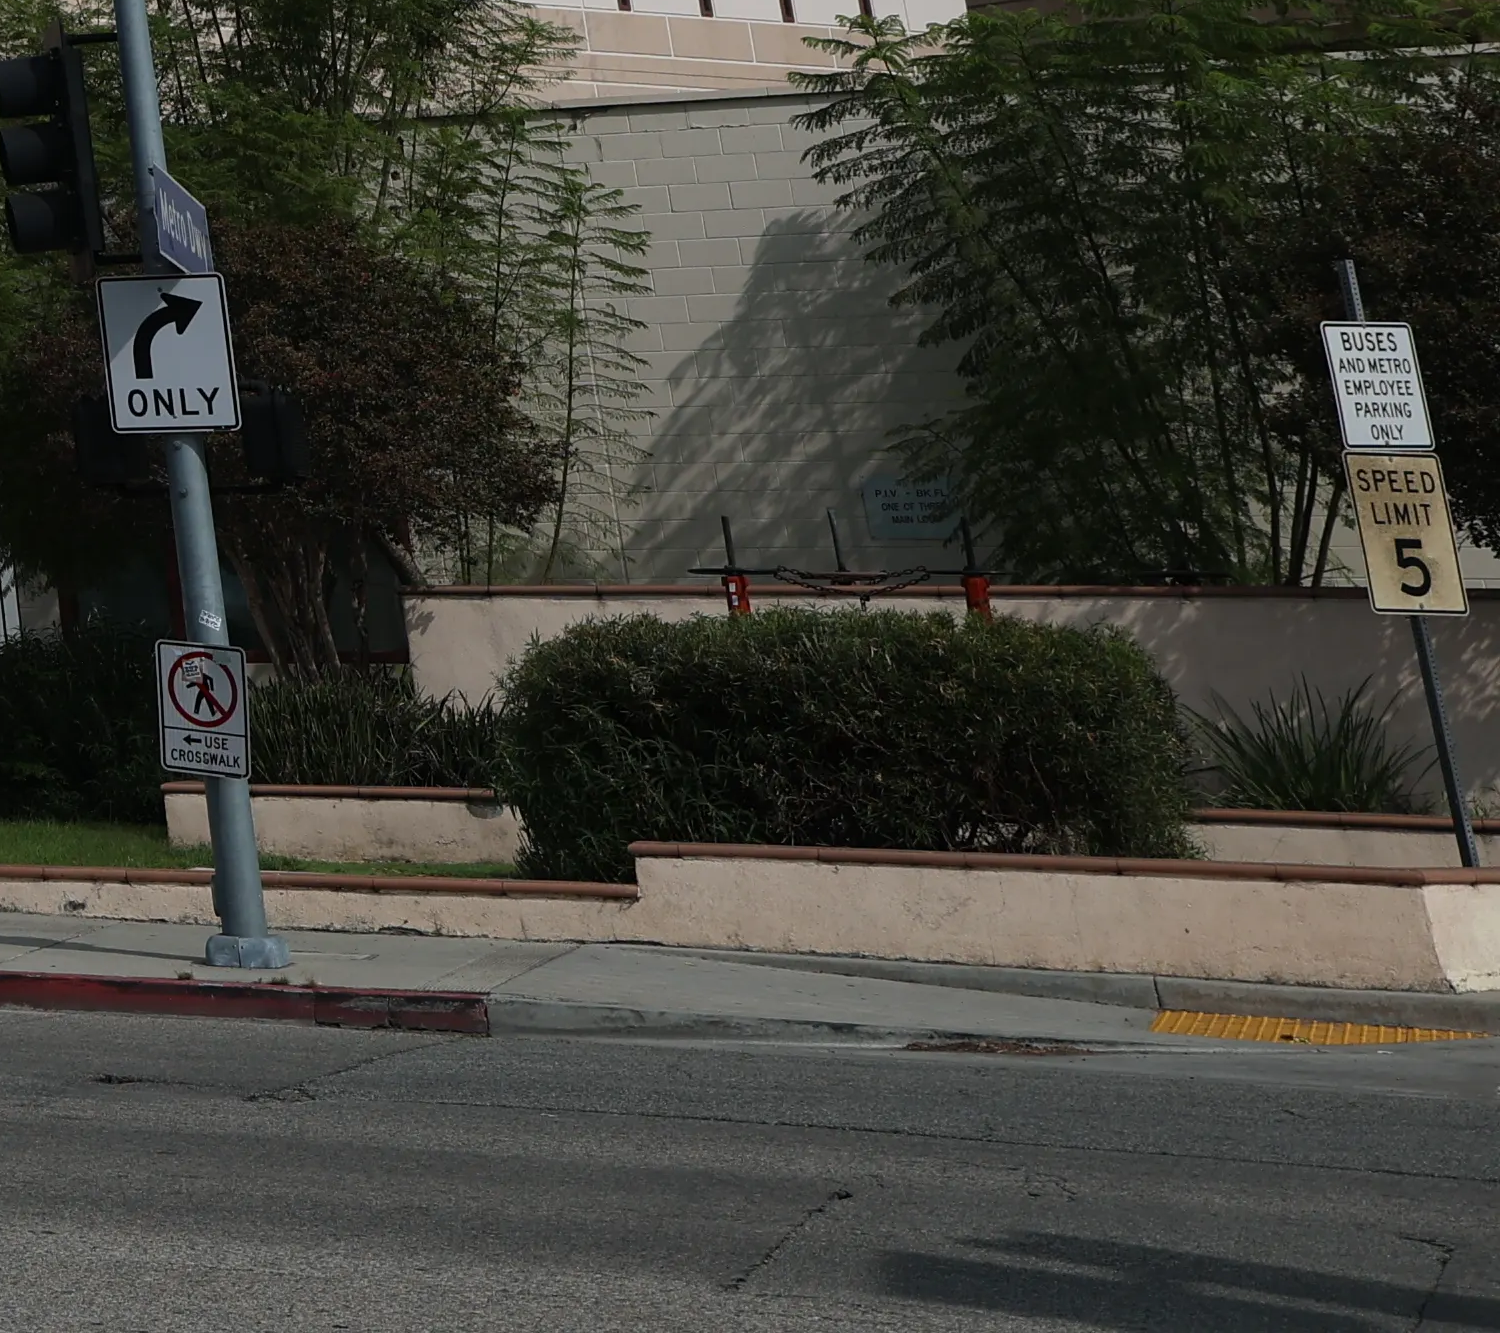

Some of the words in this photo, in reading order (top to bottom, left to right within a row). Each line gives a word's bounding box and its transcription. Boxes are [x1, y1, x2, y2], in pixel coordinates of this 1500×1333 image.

[160, 187, 187, 248] Metro
[1340, 332, 1397, 352] BUSES
[1338, 358, 1365, 374] AND
[1369, 358, 1412, 374] METRO
[1344, 380, 1414, 396] EMPLOYEE
[128, 387, 219, 417] ONLY
[1355, 402, 1412, 418] PARKING
[1370, 424, 1404, 441] ONLY
[1356, 469, 1436, 493] SPEED
[881, 502, 900, 511] ONE
[1370, 502, 1432, 526] LIMIT
[1393, 538, 1432, 597] 5
[205, 736, 229, 751] USE
[170, 748, 240, 769] CROSSWALK
